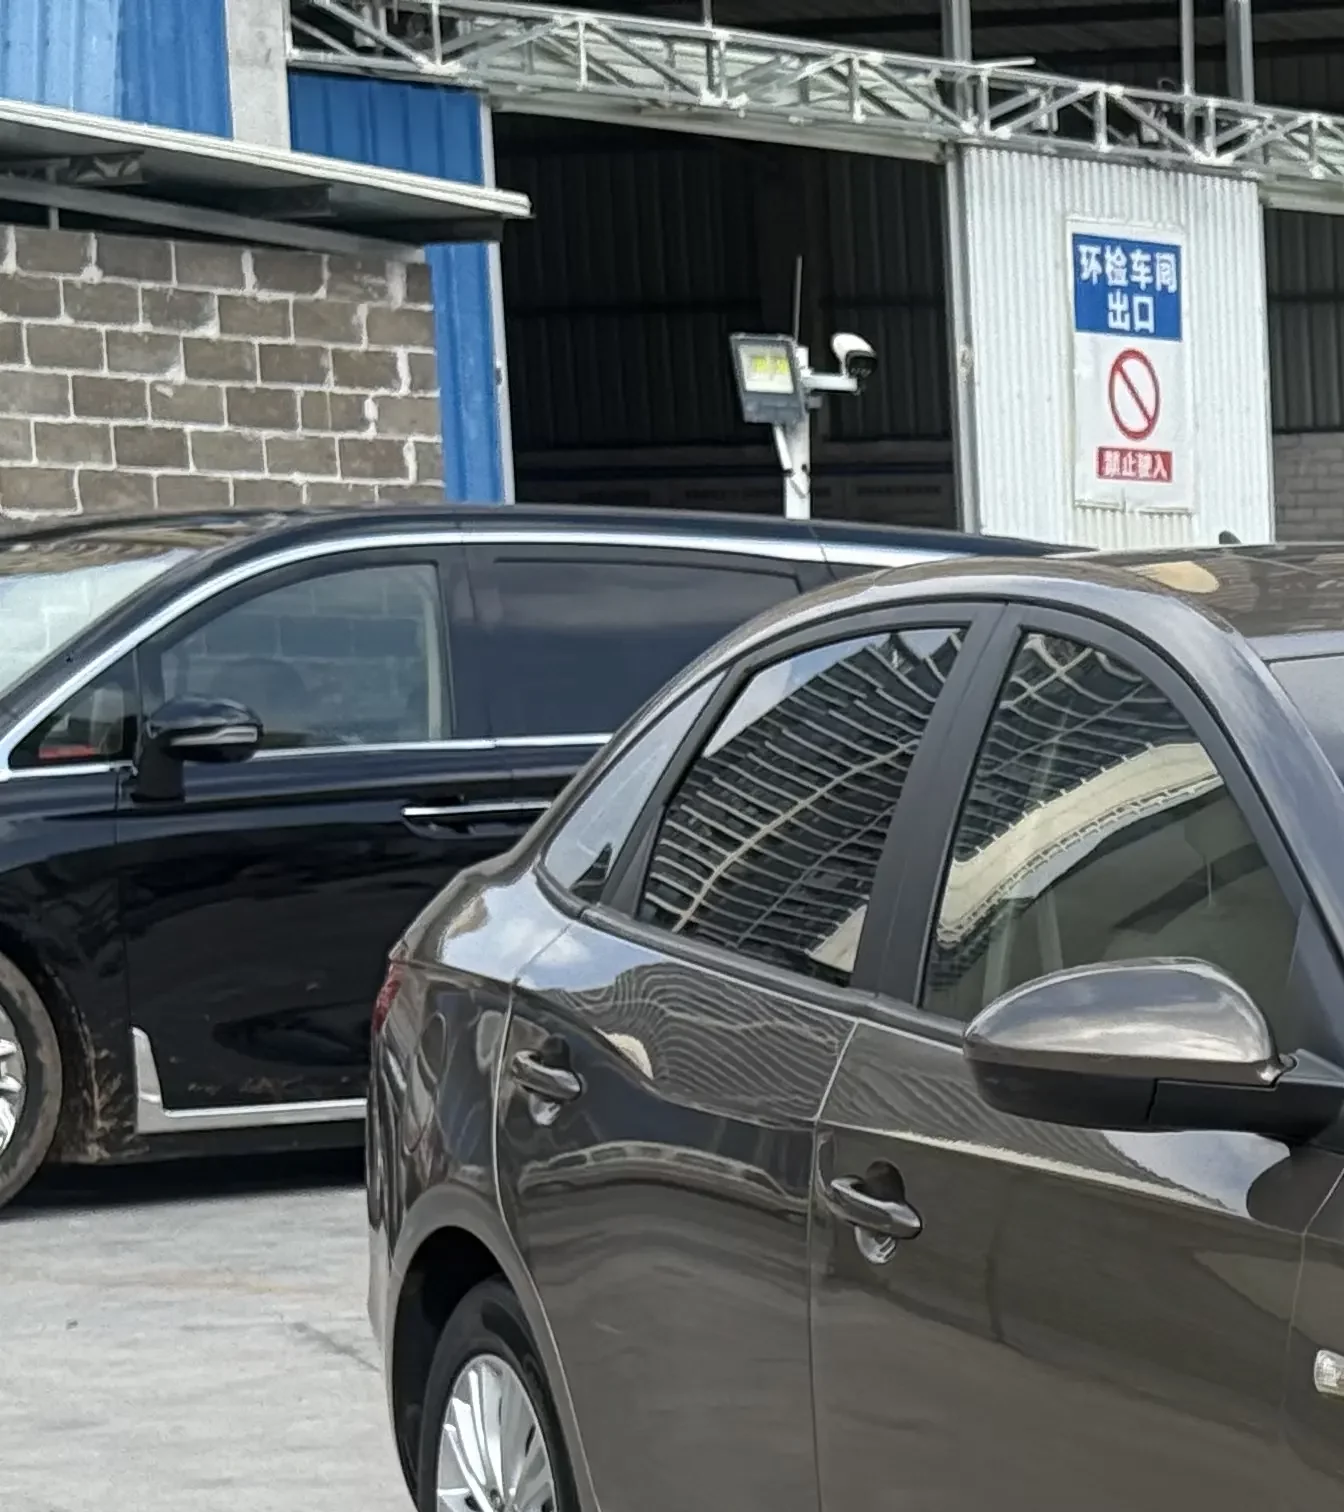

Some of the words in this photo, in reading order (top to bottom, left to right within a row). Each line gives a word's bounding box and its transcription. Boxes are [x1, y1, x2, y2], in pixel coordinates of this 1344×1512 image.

[1078, 243, 1178, 294] 环检车间
[1107, 288, 1155, 334] 出口
